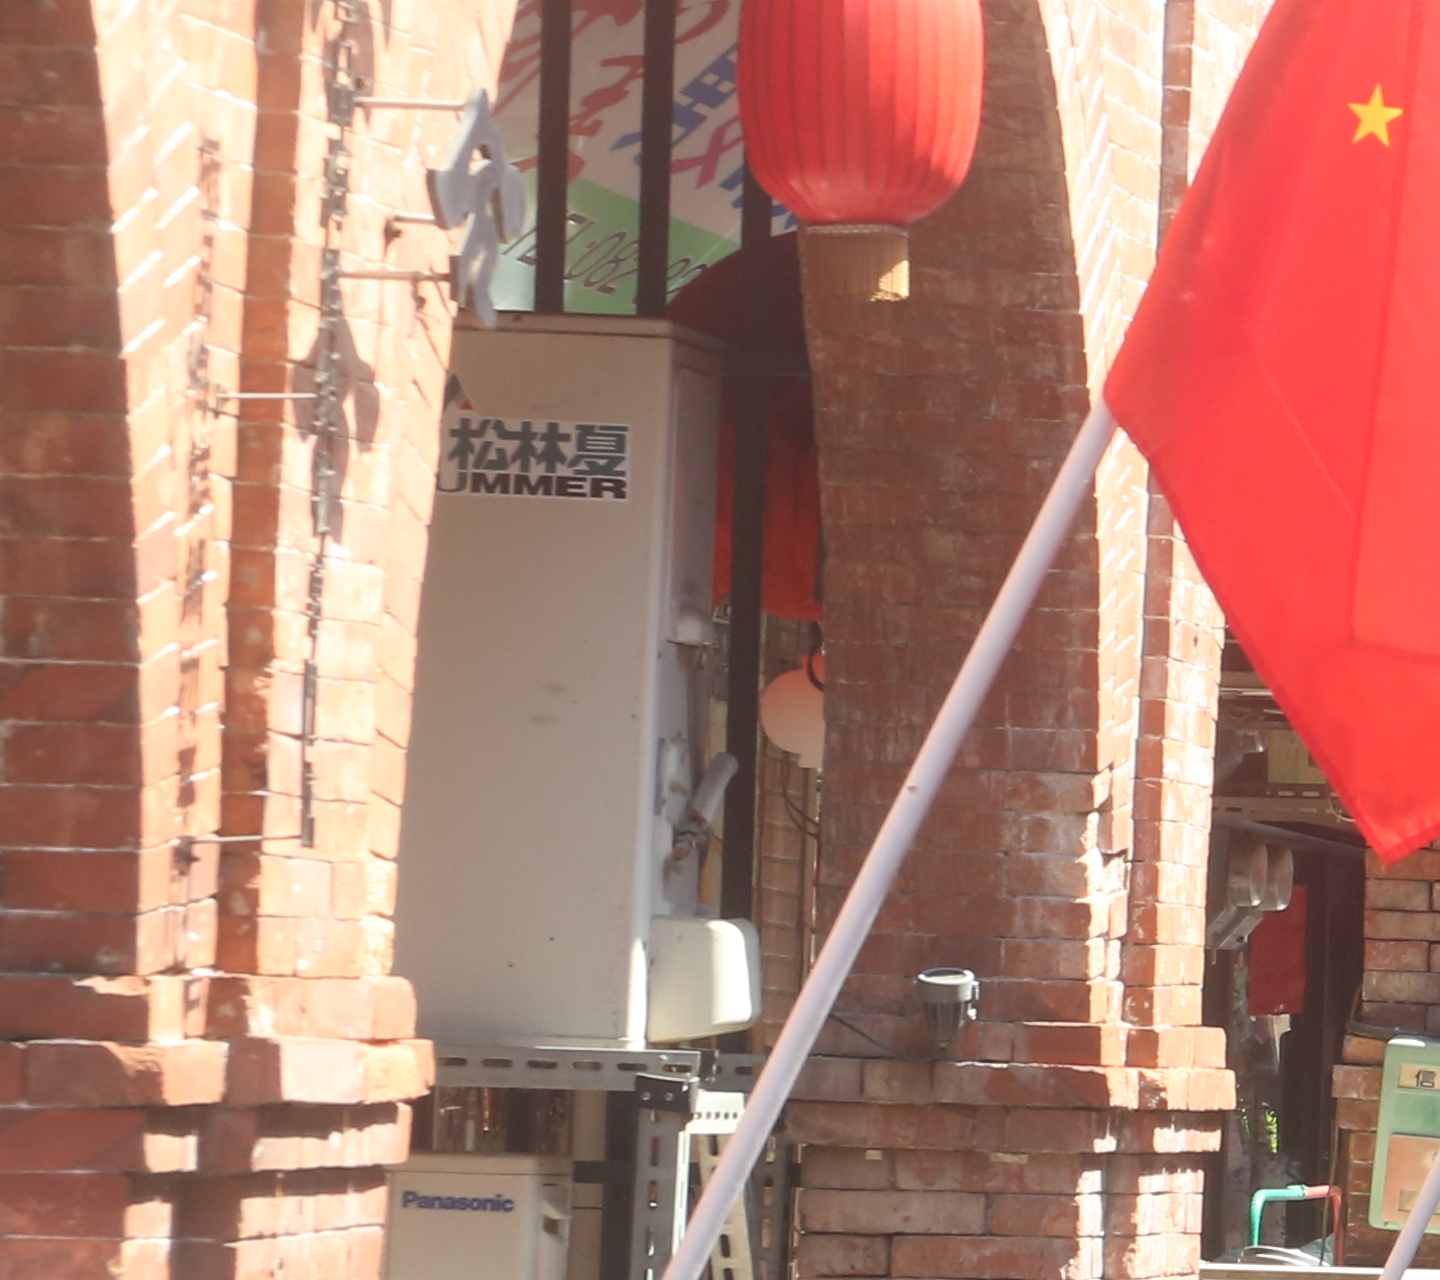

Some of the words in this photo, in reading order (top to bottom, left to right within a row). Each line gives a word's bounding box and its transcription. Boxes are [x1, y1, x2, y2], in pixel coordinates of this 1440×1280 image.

[447, 417, 629, 477] 松林夏
[402, 1190, 515, 1213] Panasonic
